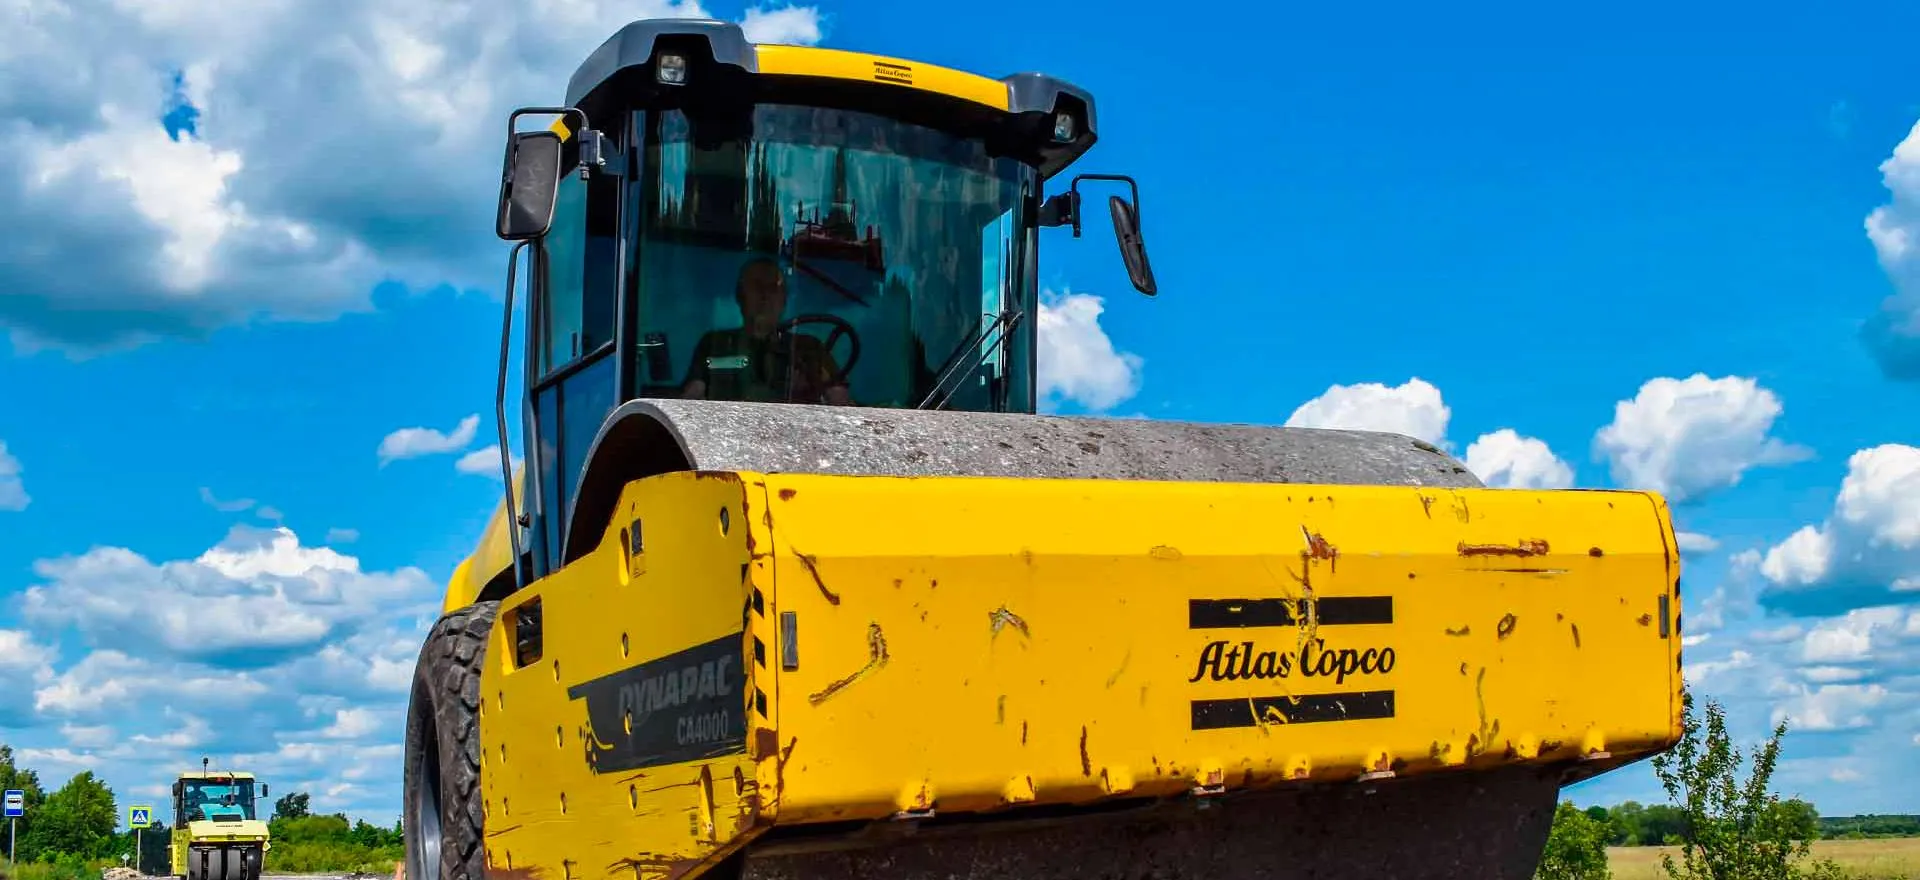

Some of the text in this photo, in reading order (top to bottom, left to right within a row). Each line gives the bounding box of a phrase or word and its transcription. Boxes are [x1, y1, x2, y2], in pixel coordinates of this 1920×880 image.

[1188, 639, 1395, 684] Atlas Copco
[618, 654, 733, 720] DYNAPAC
[677, 710, 729, 745] CA4000
